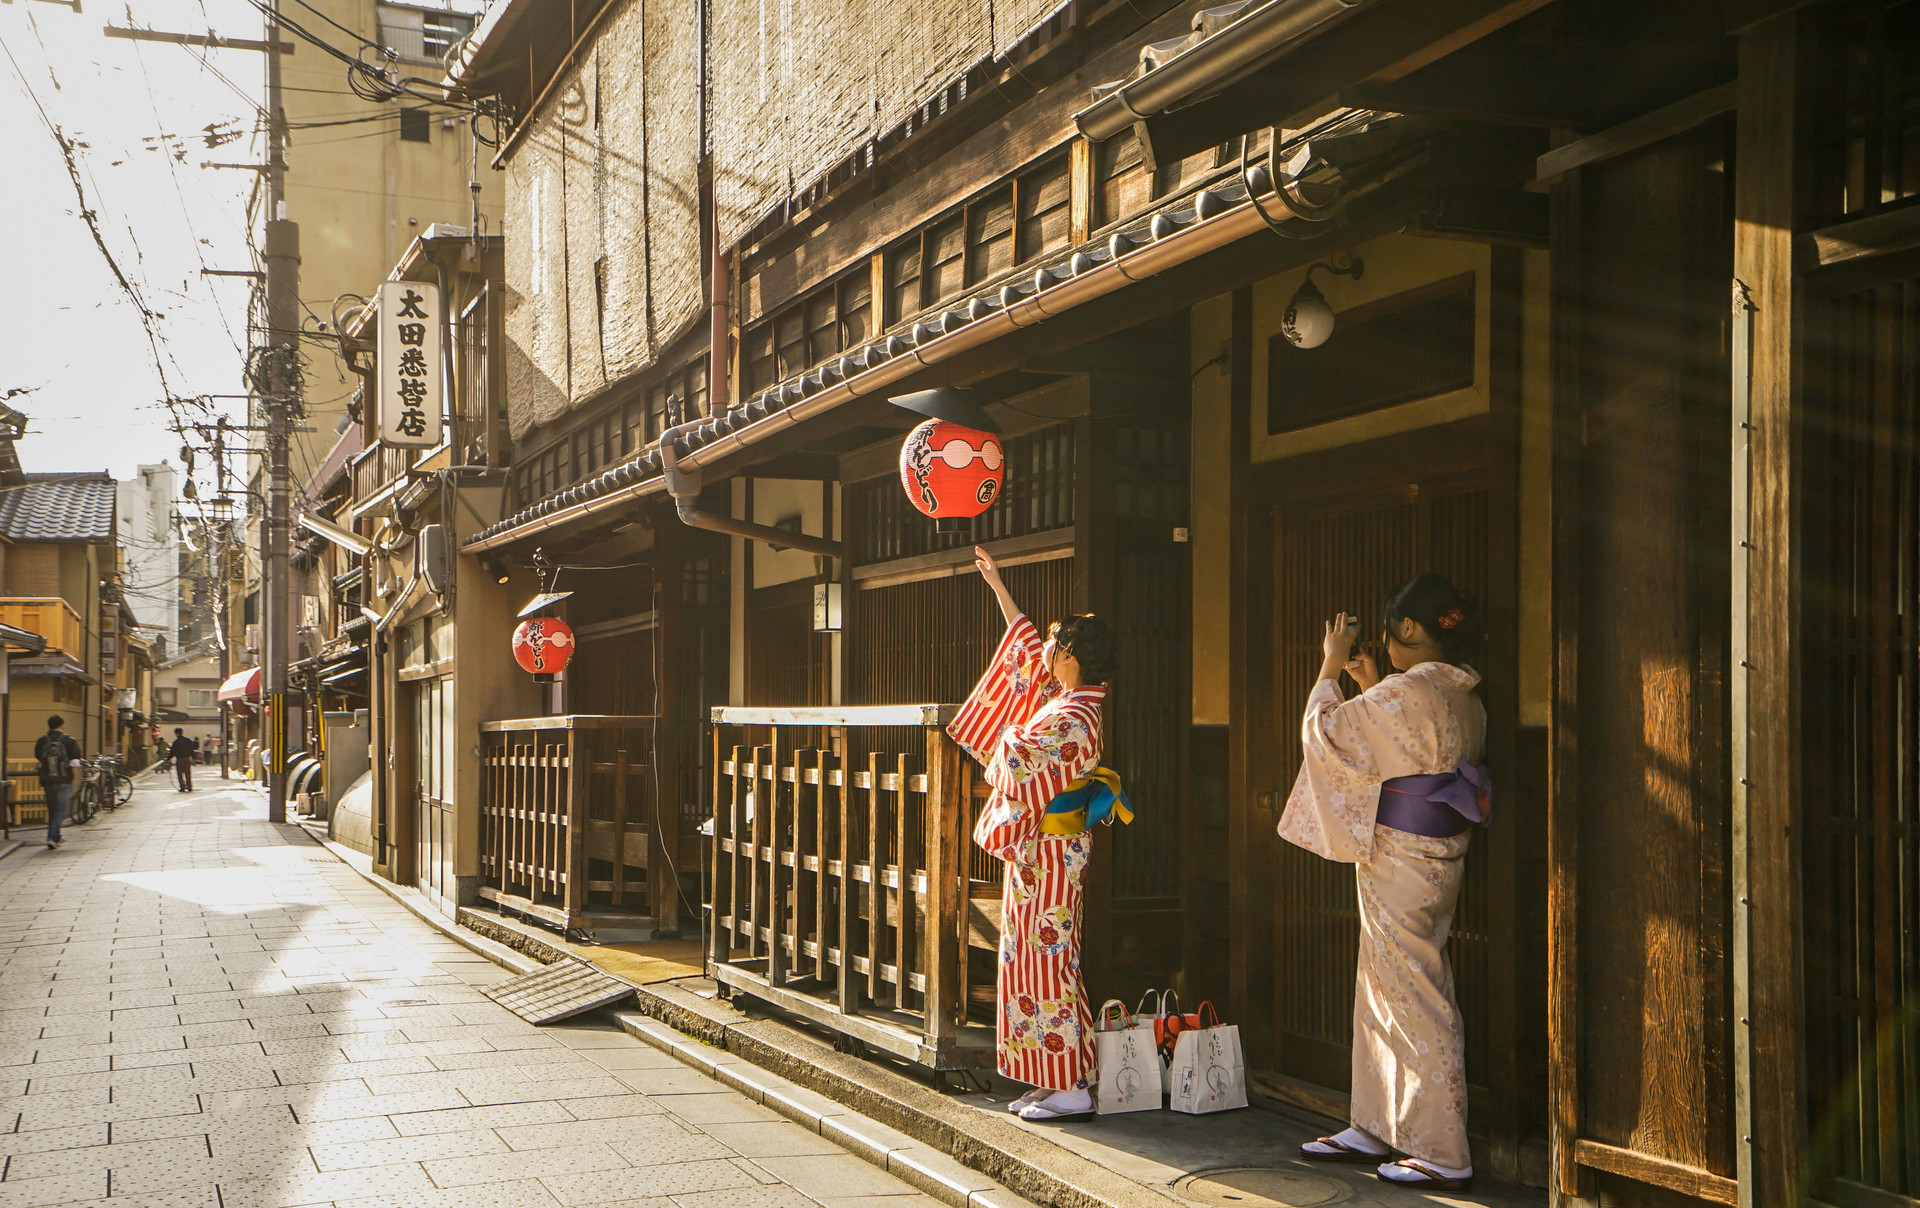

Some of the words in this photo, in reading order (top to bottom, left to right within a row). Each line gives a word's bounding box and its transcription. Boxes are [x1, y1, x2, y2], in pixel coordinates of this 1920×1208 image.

[395, 289, 430, 437] 太田悉皆店
[527, 621, 545, 671] 都をどり
